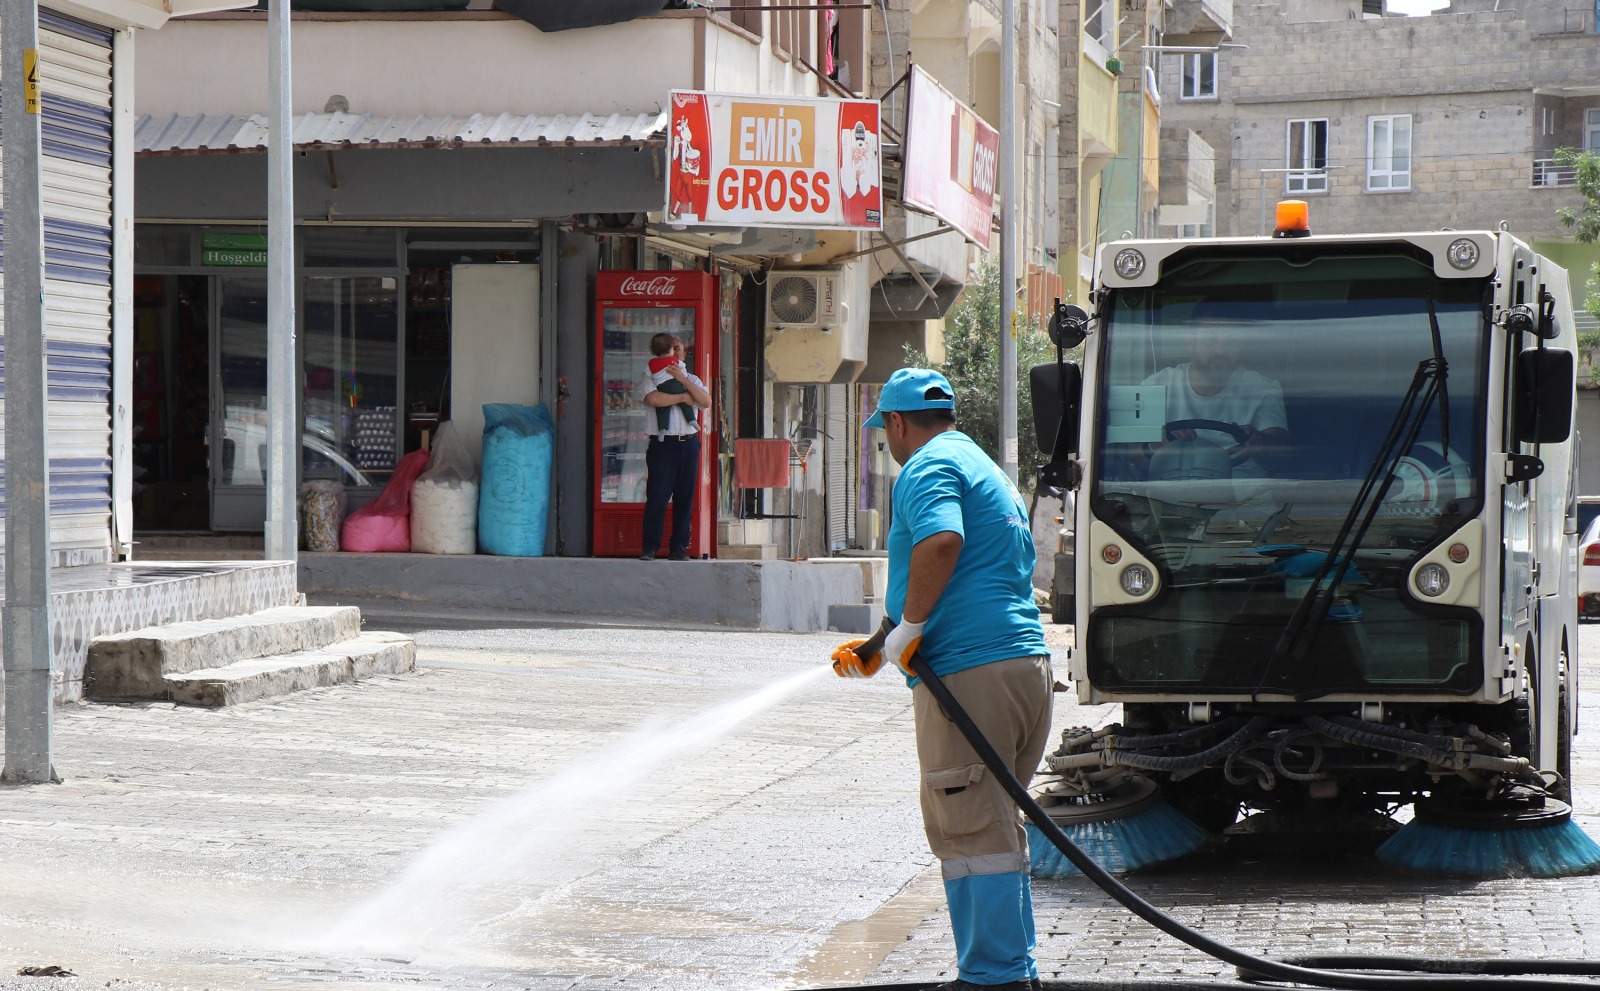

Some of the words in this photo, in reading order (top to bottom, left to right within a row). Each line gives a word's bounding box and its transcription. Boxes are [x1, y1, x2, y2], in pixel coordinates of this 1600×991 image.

[739, 107, 803, 163] EMİR
[717, 167, 830, 214] GROSS
[973, 141, 995, 195] GROSS
[208, 251, 267, 265] Hoşgeldi
[620, 276, 678, 296] Coca-Cola
